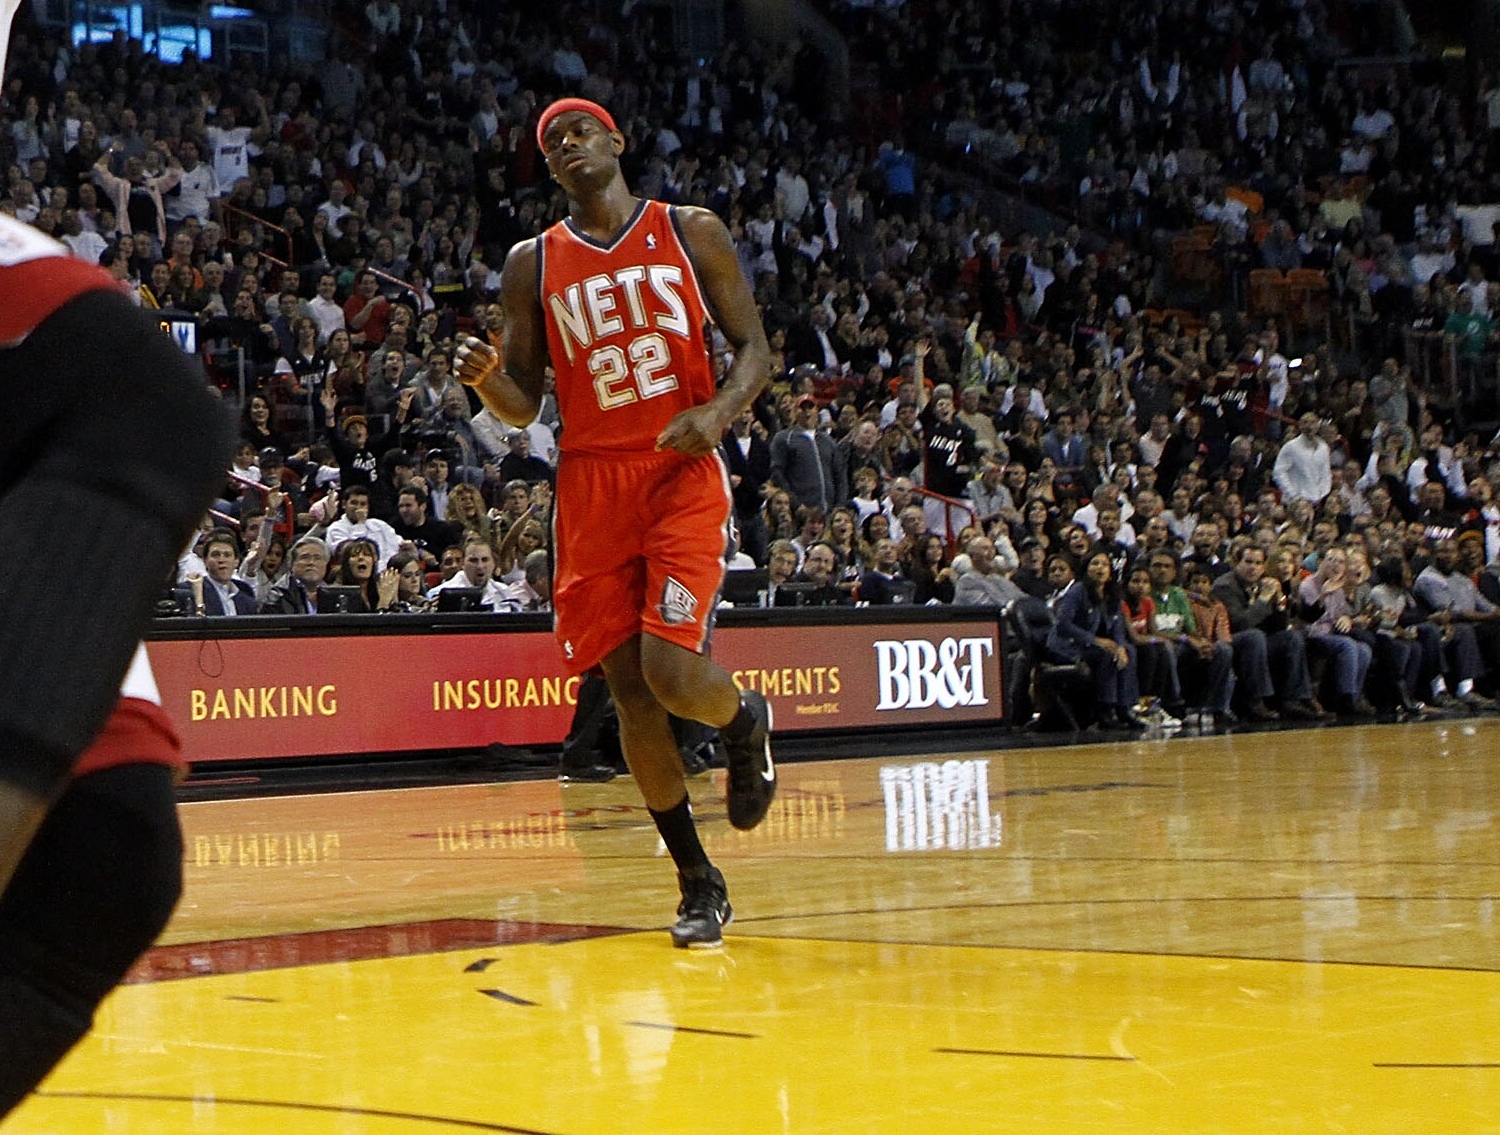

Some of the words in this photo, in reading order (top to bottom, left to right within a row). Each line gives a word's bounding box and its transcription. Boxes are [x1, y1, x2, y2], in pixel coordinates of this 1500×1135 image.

[548, 264, 690, 366] NETS
[588, 332, 679, 410] 22
[433, 676, 580, 711] INSURANC
[731, 667, 841, 697] STMENTS
[873, 637, 993, 711] BB&T
[192, 685, 338, 721] BANKING
